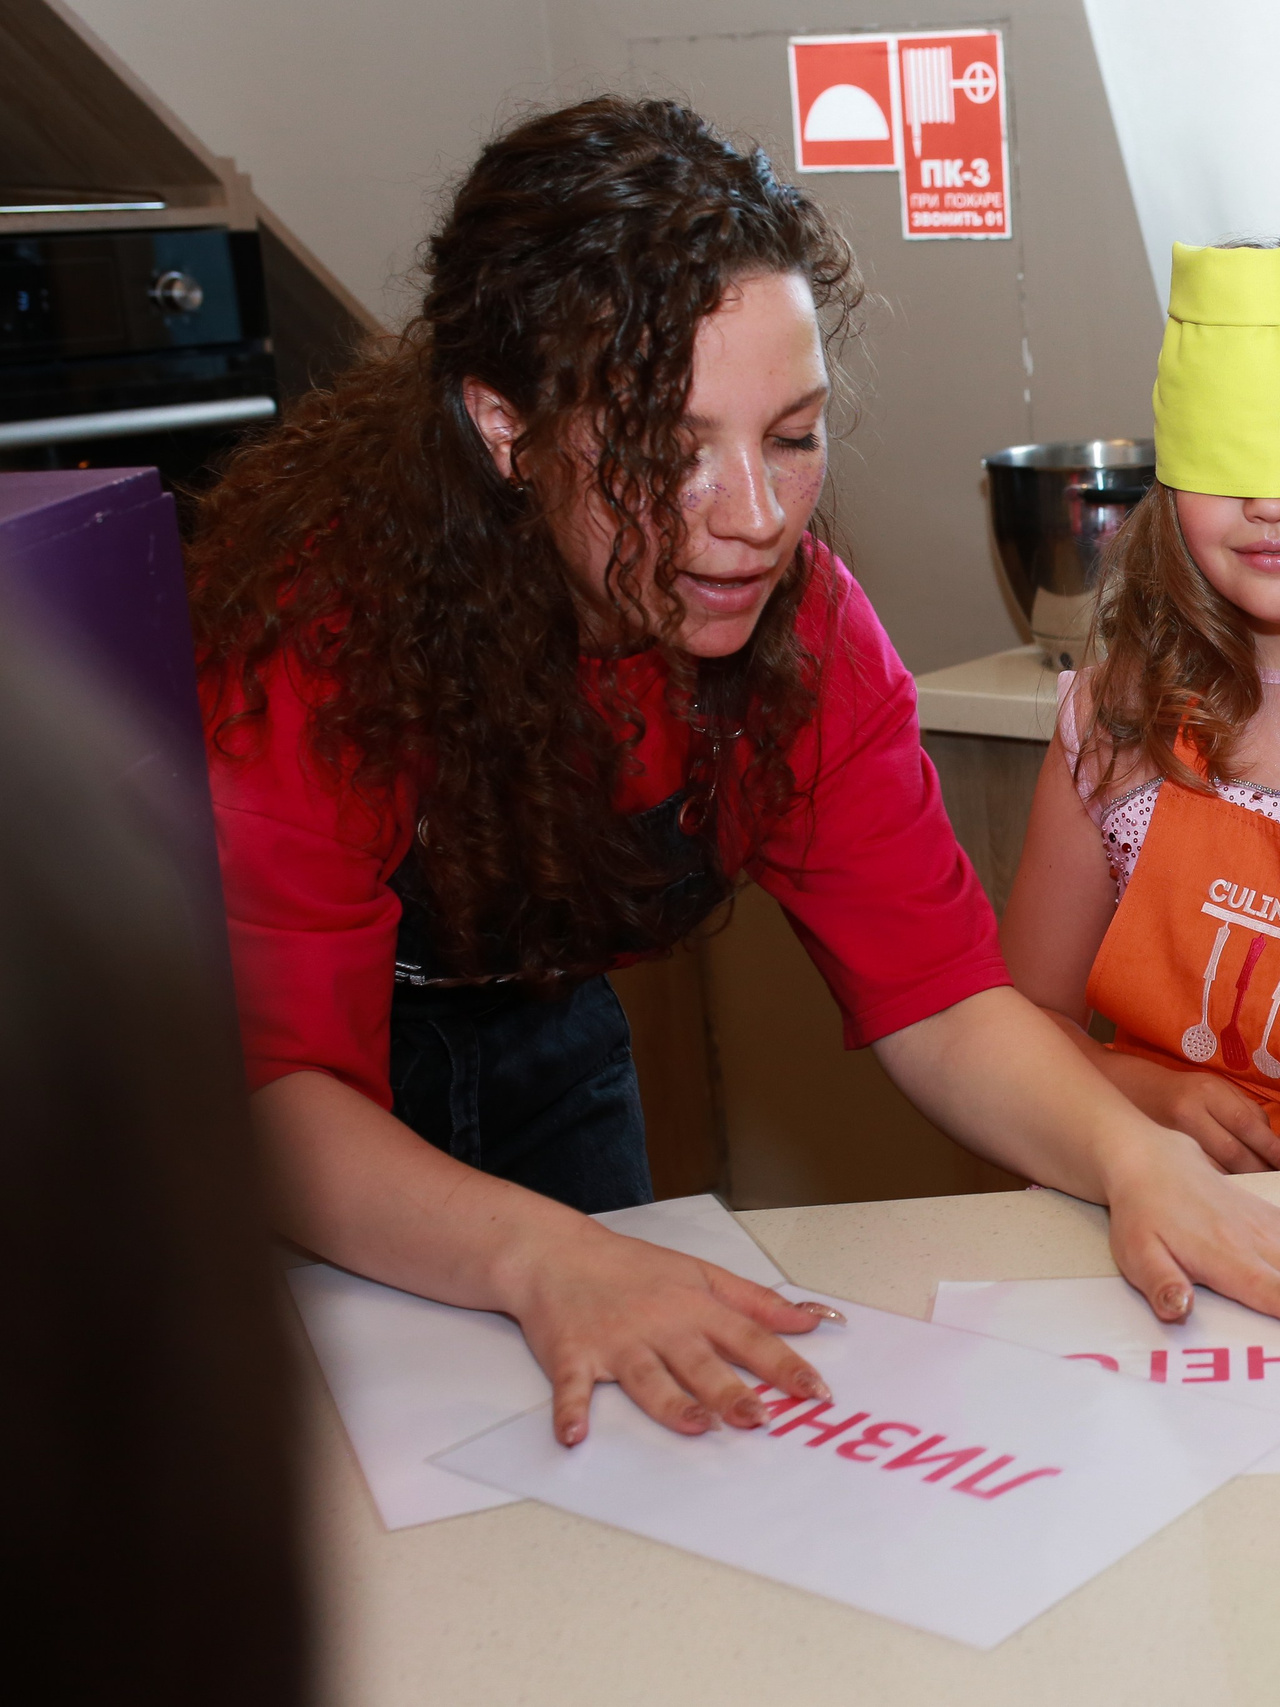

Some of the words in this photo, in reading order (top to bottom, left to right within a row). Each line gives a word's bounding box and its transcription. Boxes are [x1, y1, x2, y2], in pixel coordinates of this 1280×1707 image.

[921, 158, 991, 188] ПК-3
[910, 193, 939, 209] ПРИ
[944, 192, 1003, 209] ПОЖАРЕ
[911, 211, 983, 227] ЗВОНИТЬ
[985, 211, 1003, 227] 01
